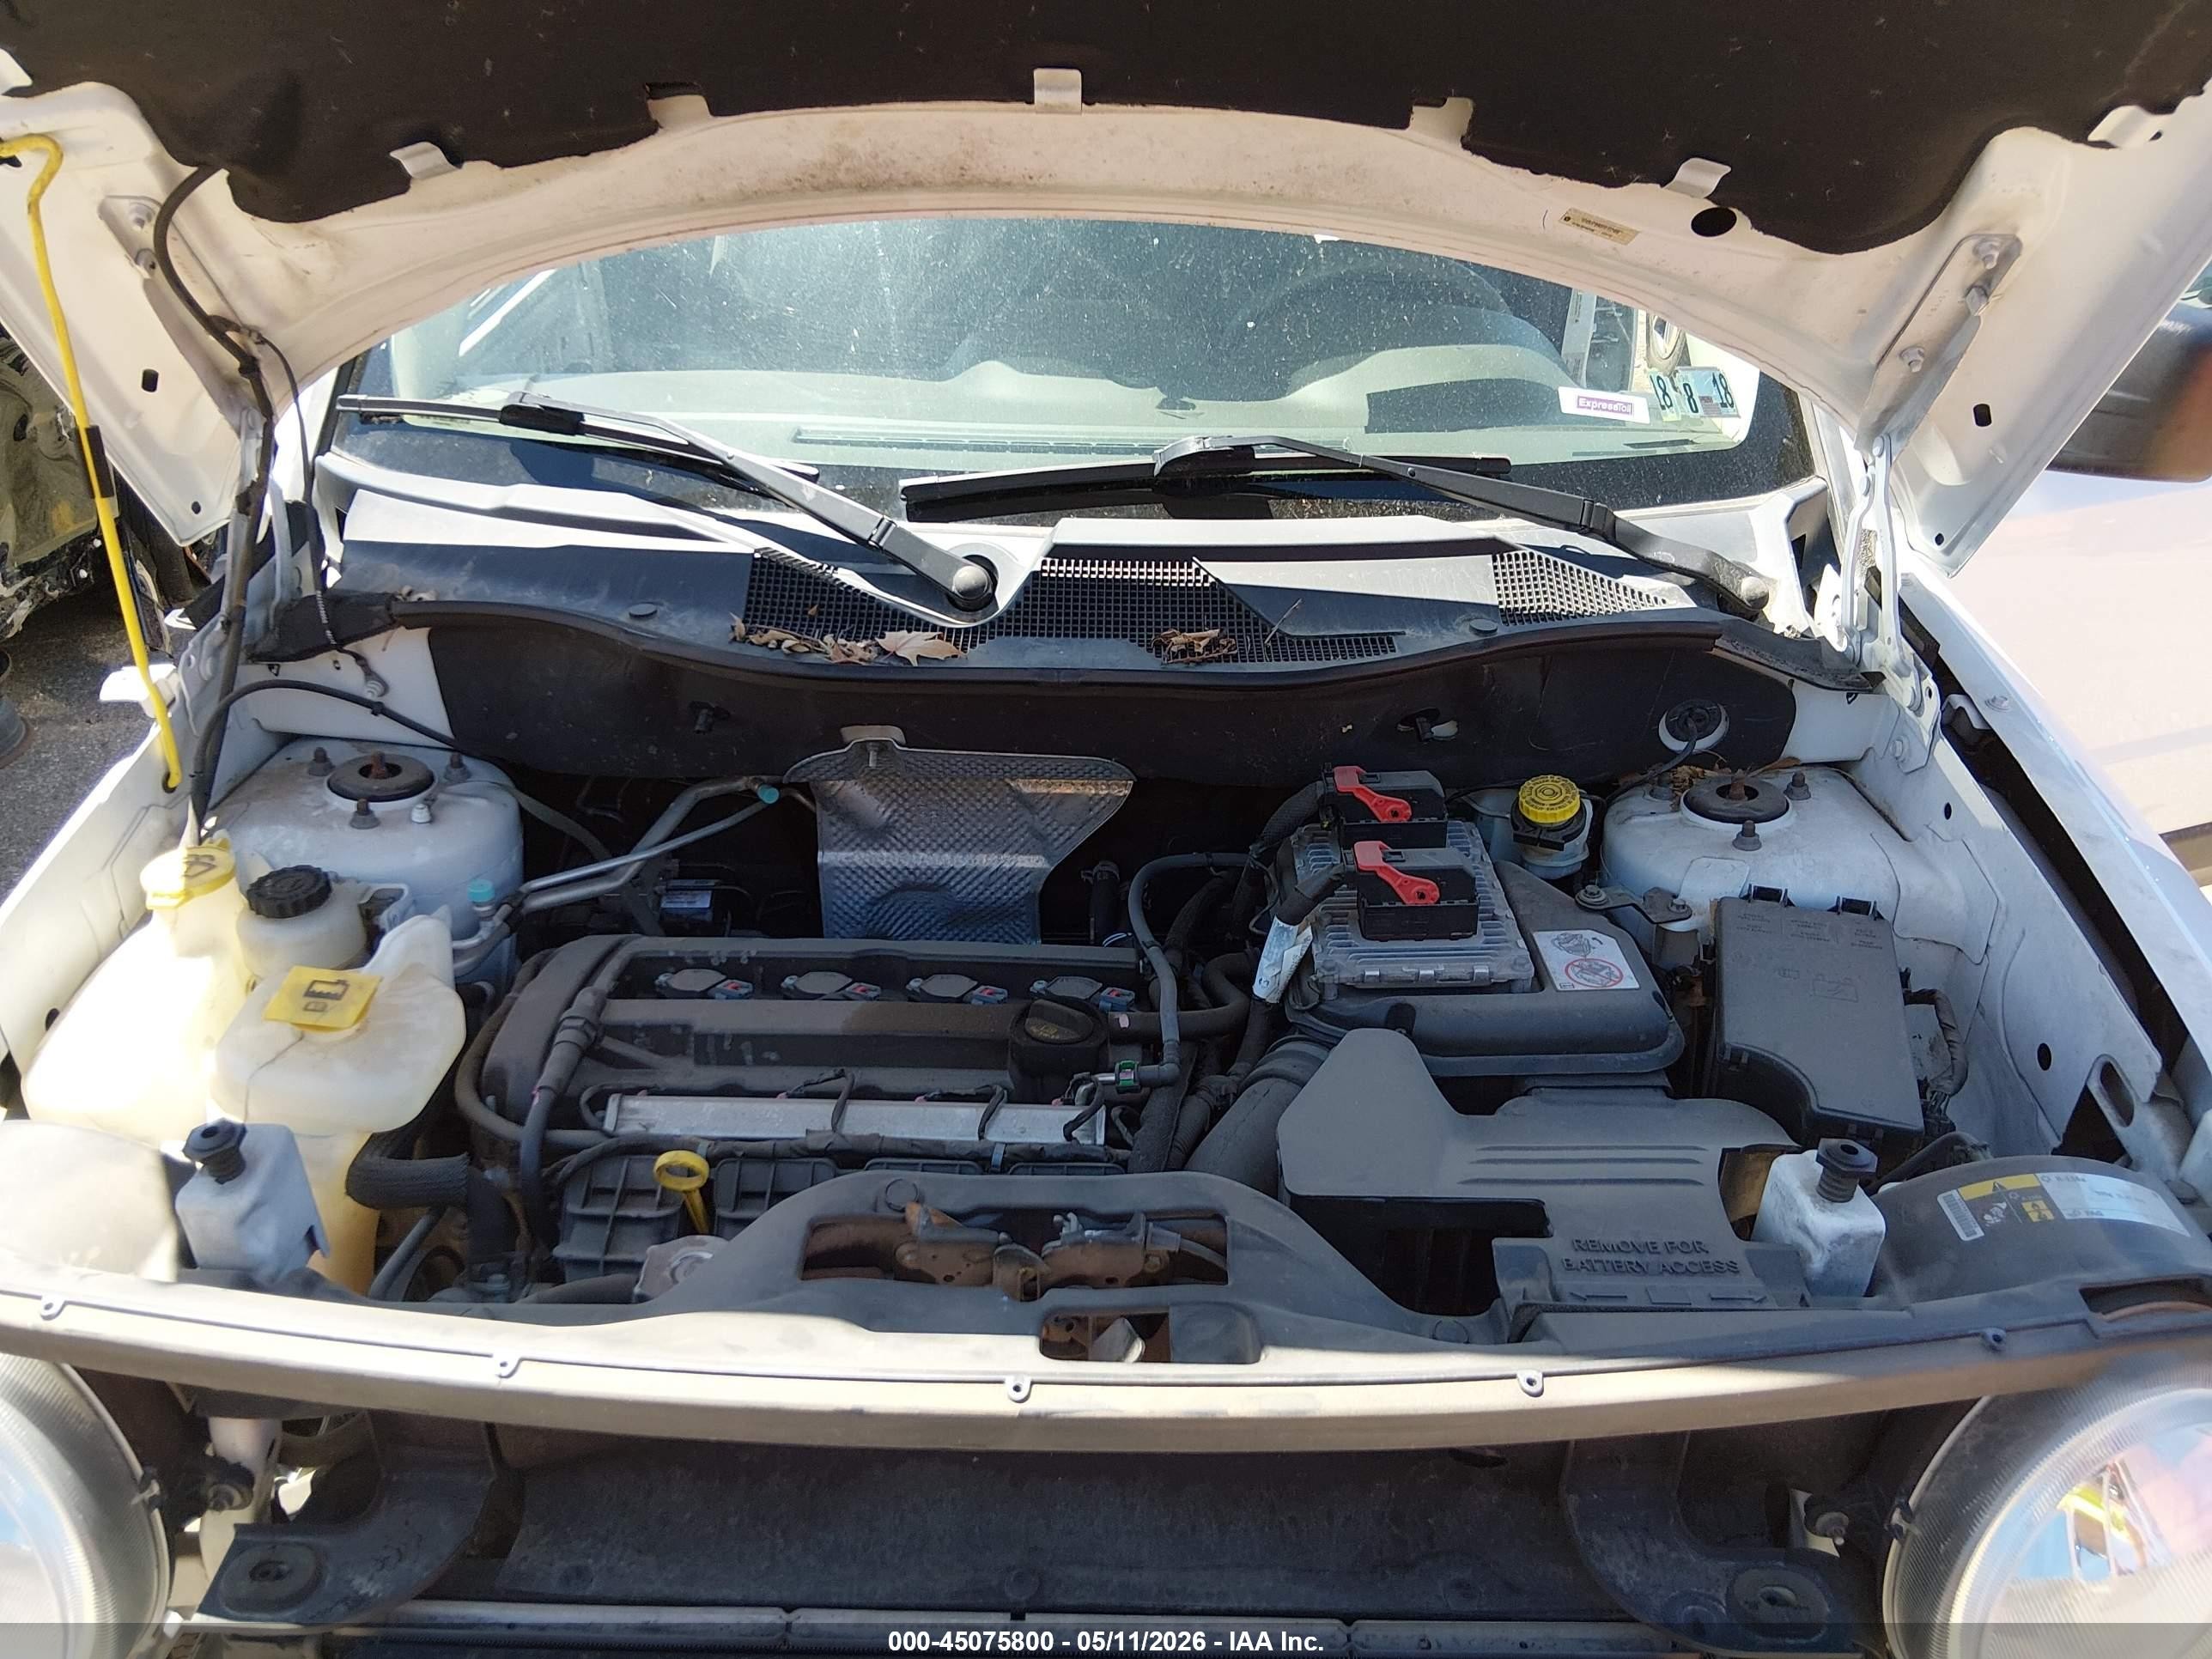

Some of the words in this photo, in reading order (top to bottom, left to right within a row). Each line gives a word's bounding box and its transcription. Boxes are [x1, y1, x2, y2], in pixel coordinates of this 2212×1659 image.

[1712, 372, 1735, 408] 18
[1578, 398, 1632, 413] ExpressToll
[1571, 1238, 1661, 1255] REMOVE
[1663, 1240, 1710, 1255] FOR
[1562, 1258, 1649, 1274] BATTERY
[1660, 1260, 1741, 1275] ACCESS
